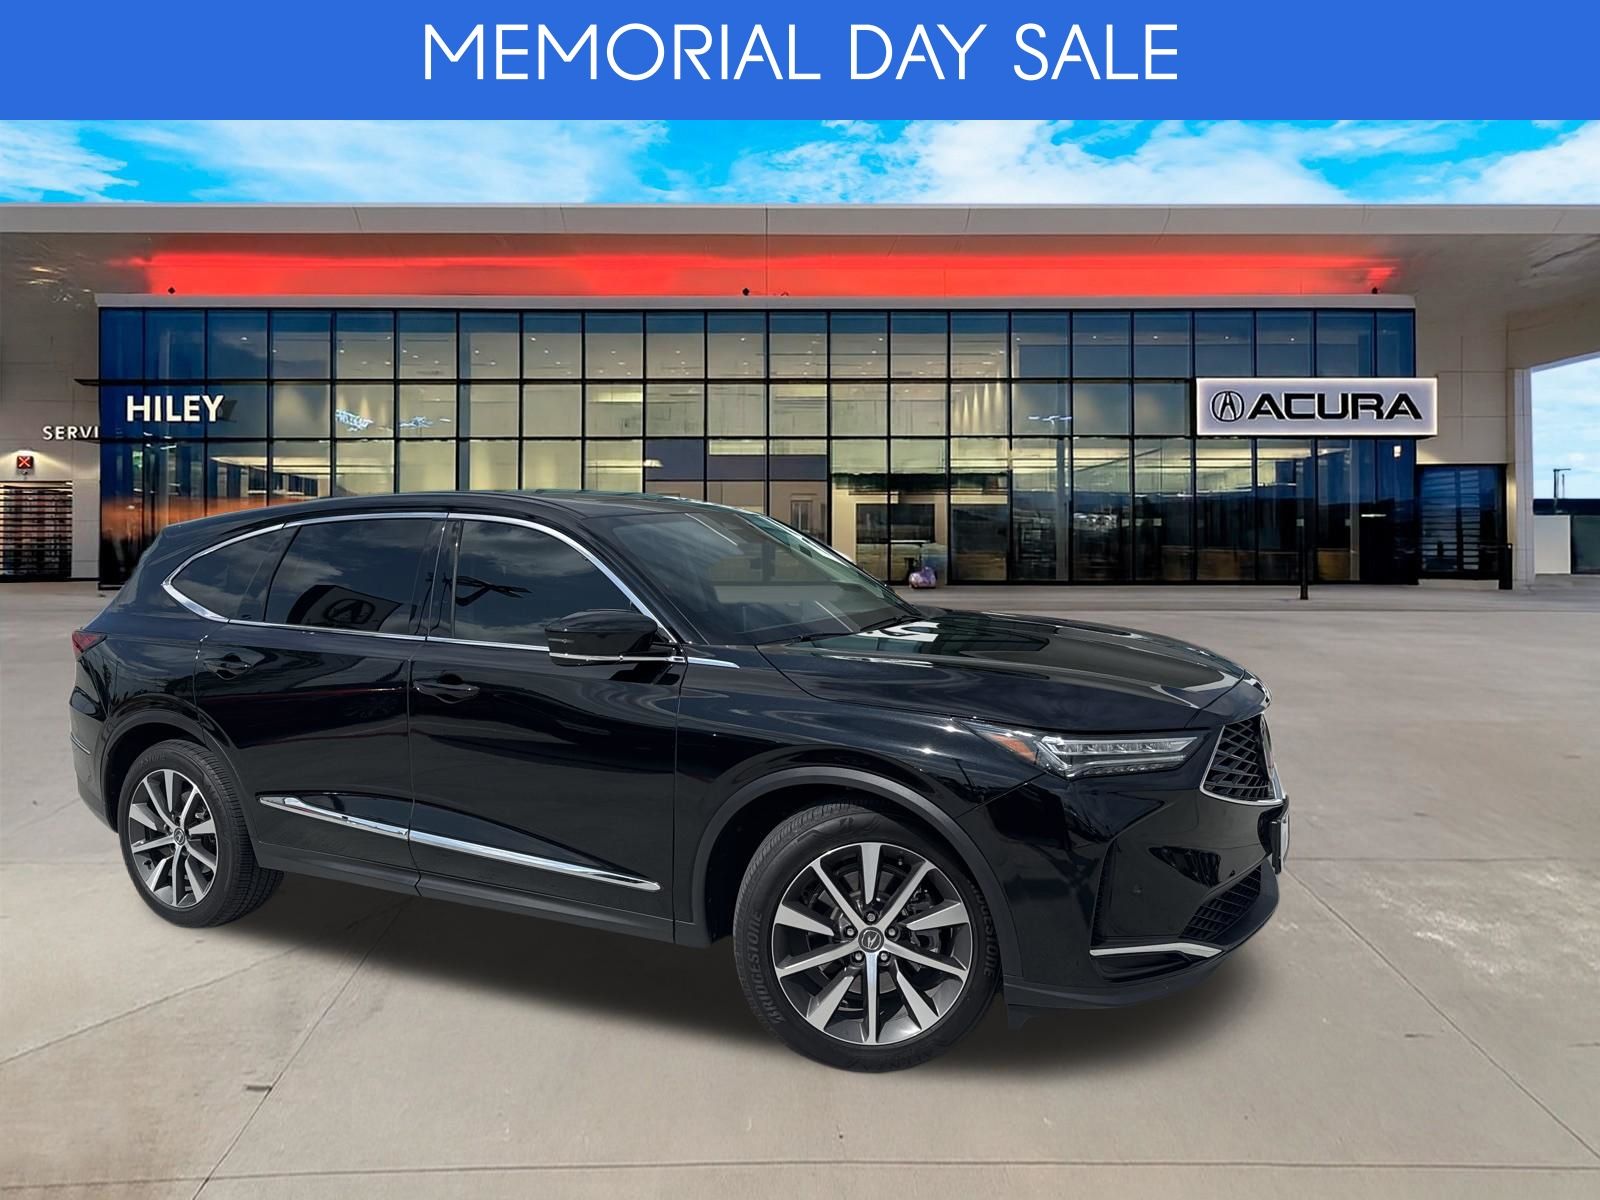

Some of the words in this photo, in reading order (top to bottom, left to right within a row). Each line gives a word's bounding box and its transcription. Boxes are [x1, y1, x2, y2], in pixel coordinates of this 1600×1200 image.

[127, 394, 223, 422] HILEY
[1247, 393, 1422, 420] ACURA
[43, 426, 99, 440] SERVI
